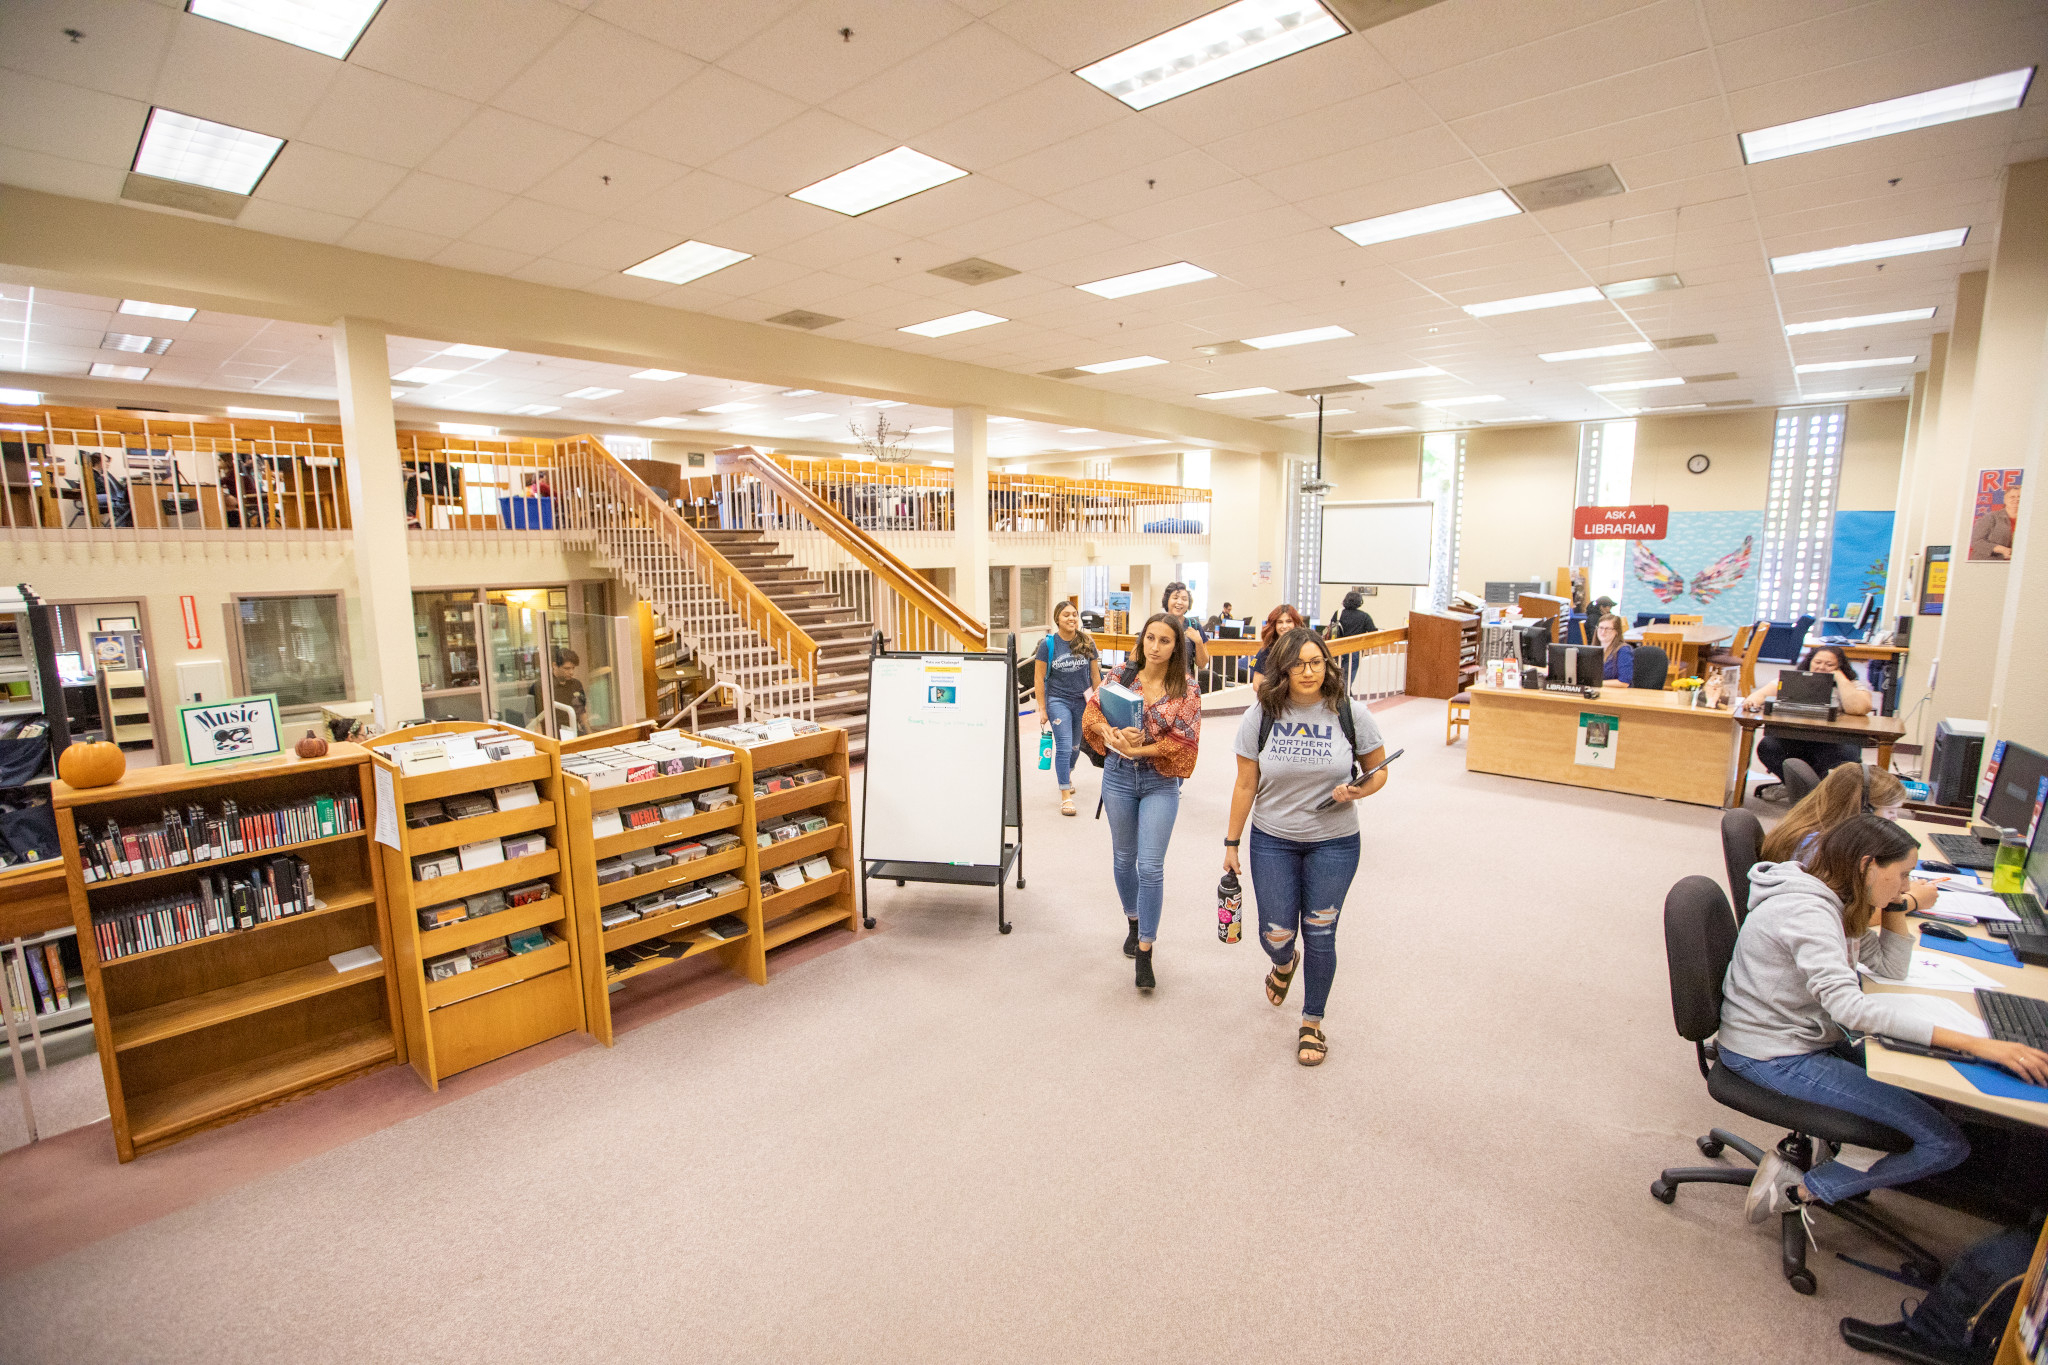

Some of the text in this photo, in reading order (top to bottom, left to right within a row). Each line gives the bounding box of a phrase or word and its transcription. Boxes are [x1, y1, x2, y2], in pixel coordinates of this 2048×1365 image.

[1604, 510, 1637, 520] ASK A
[1584, 523, 1656, 535] LIBRARIAN
[1546, 683, 1581, 693] LIBRARIAN
[194, 704, 259, 732] Music
[1273, 722, 1332, 740] NAU
[1271, 738, 1332, 748] NORTHERN
[1270, 745, 1333, 757] ARIZONA
[1267, 754, 1333, 765] UNIVERSITY
[628, 764, 656, 780] MOTOWN
[630, 807, 660, 825] MERLE
